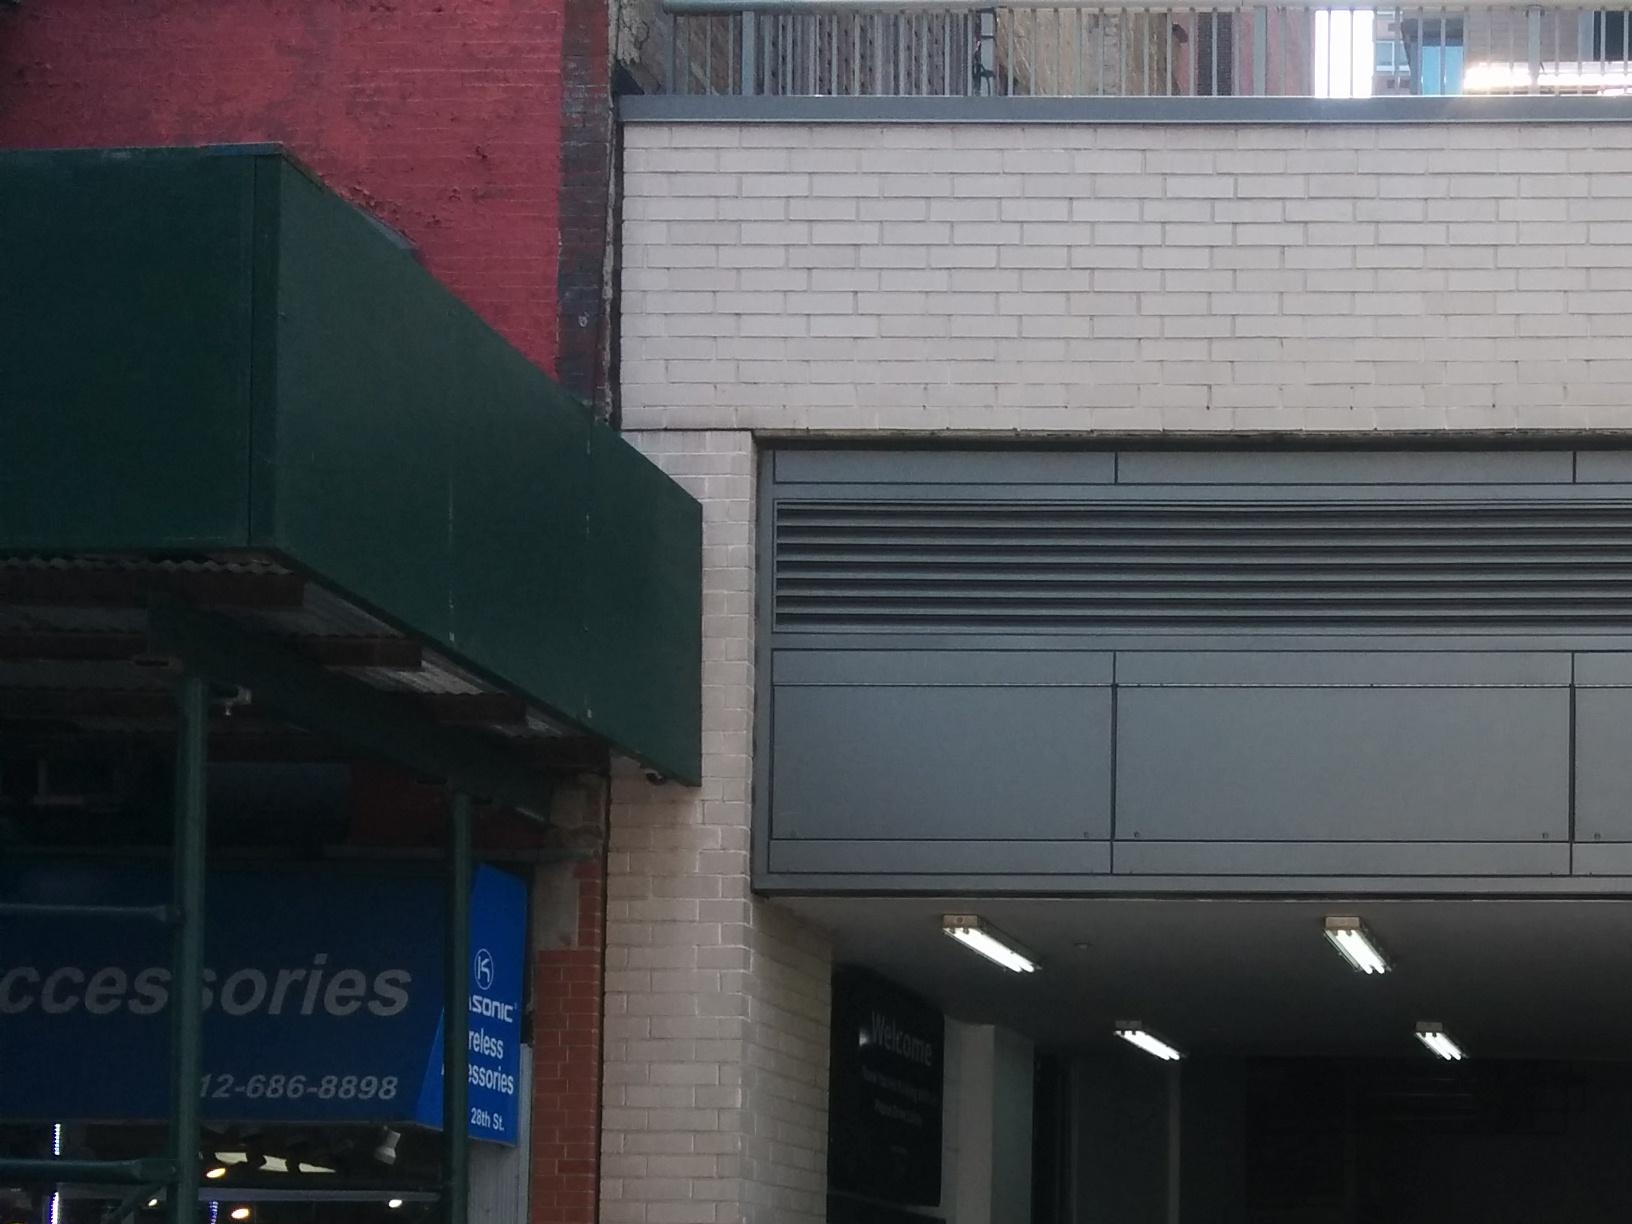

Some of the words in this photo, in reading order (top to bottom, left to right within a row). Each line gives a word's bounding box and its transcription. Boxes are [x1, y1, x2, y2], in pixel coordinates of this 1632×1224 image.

[469, 995, 514, 1023] SONIC
[468, 1028, 504, 1059] reless
[871, 1010, 932, 1067] Welcome
[200, 1073, 399, 1100] 12-686-8898
[469, 1064, 514, 1095] ssories
[471, 1108, 490, 1128] 28th
